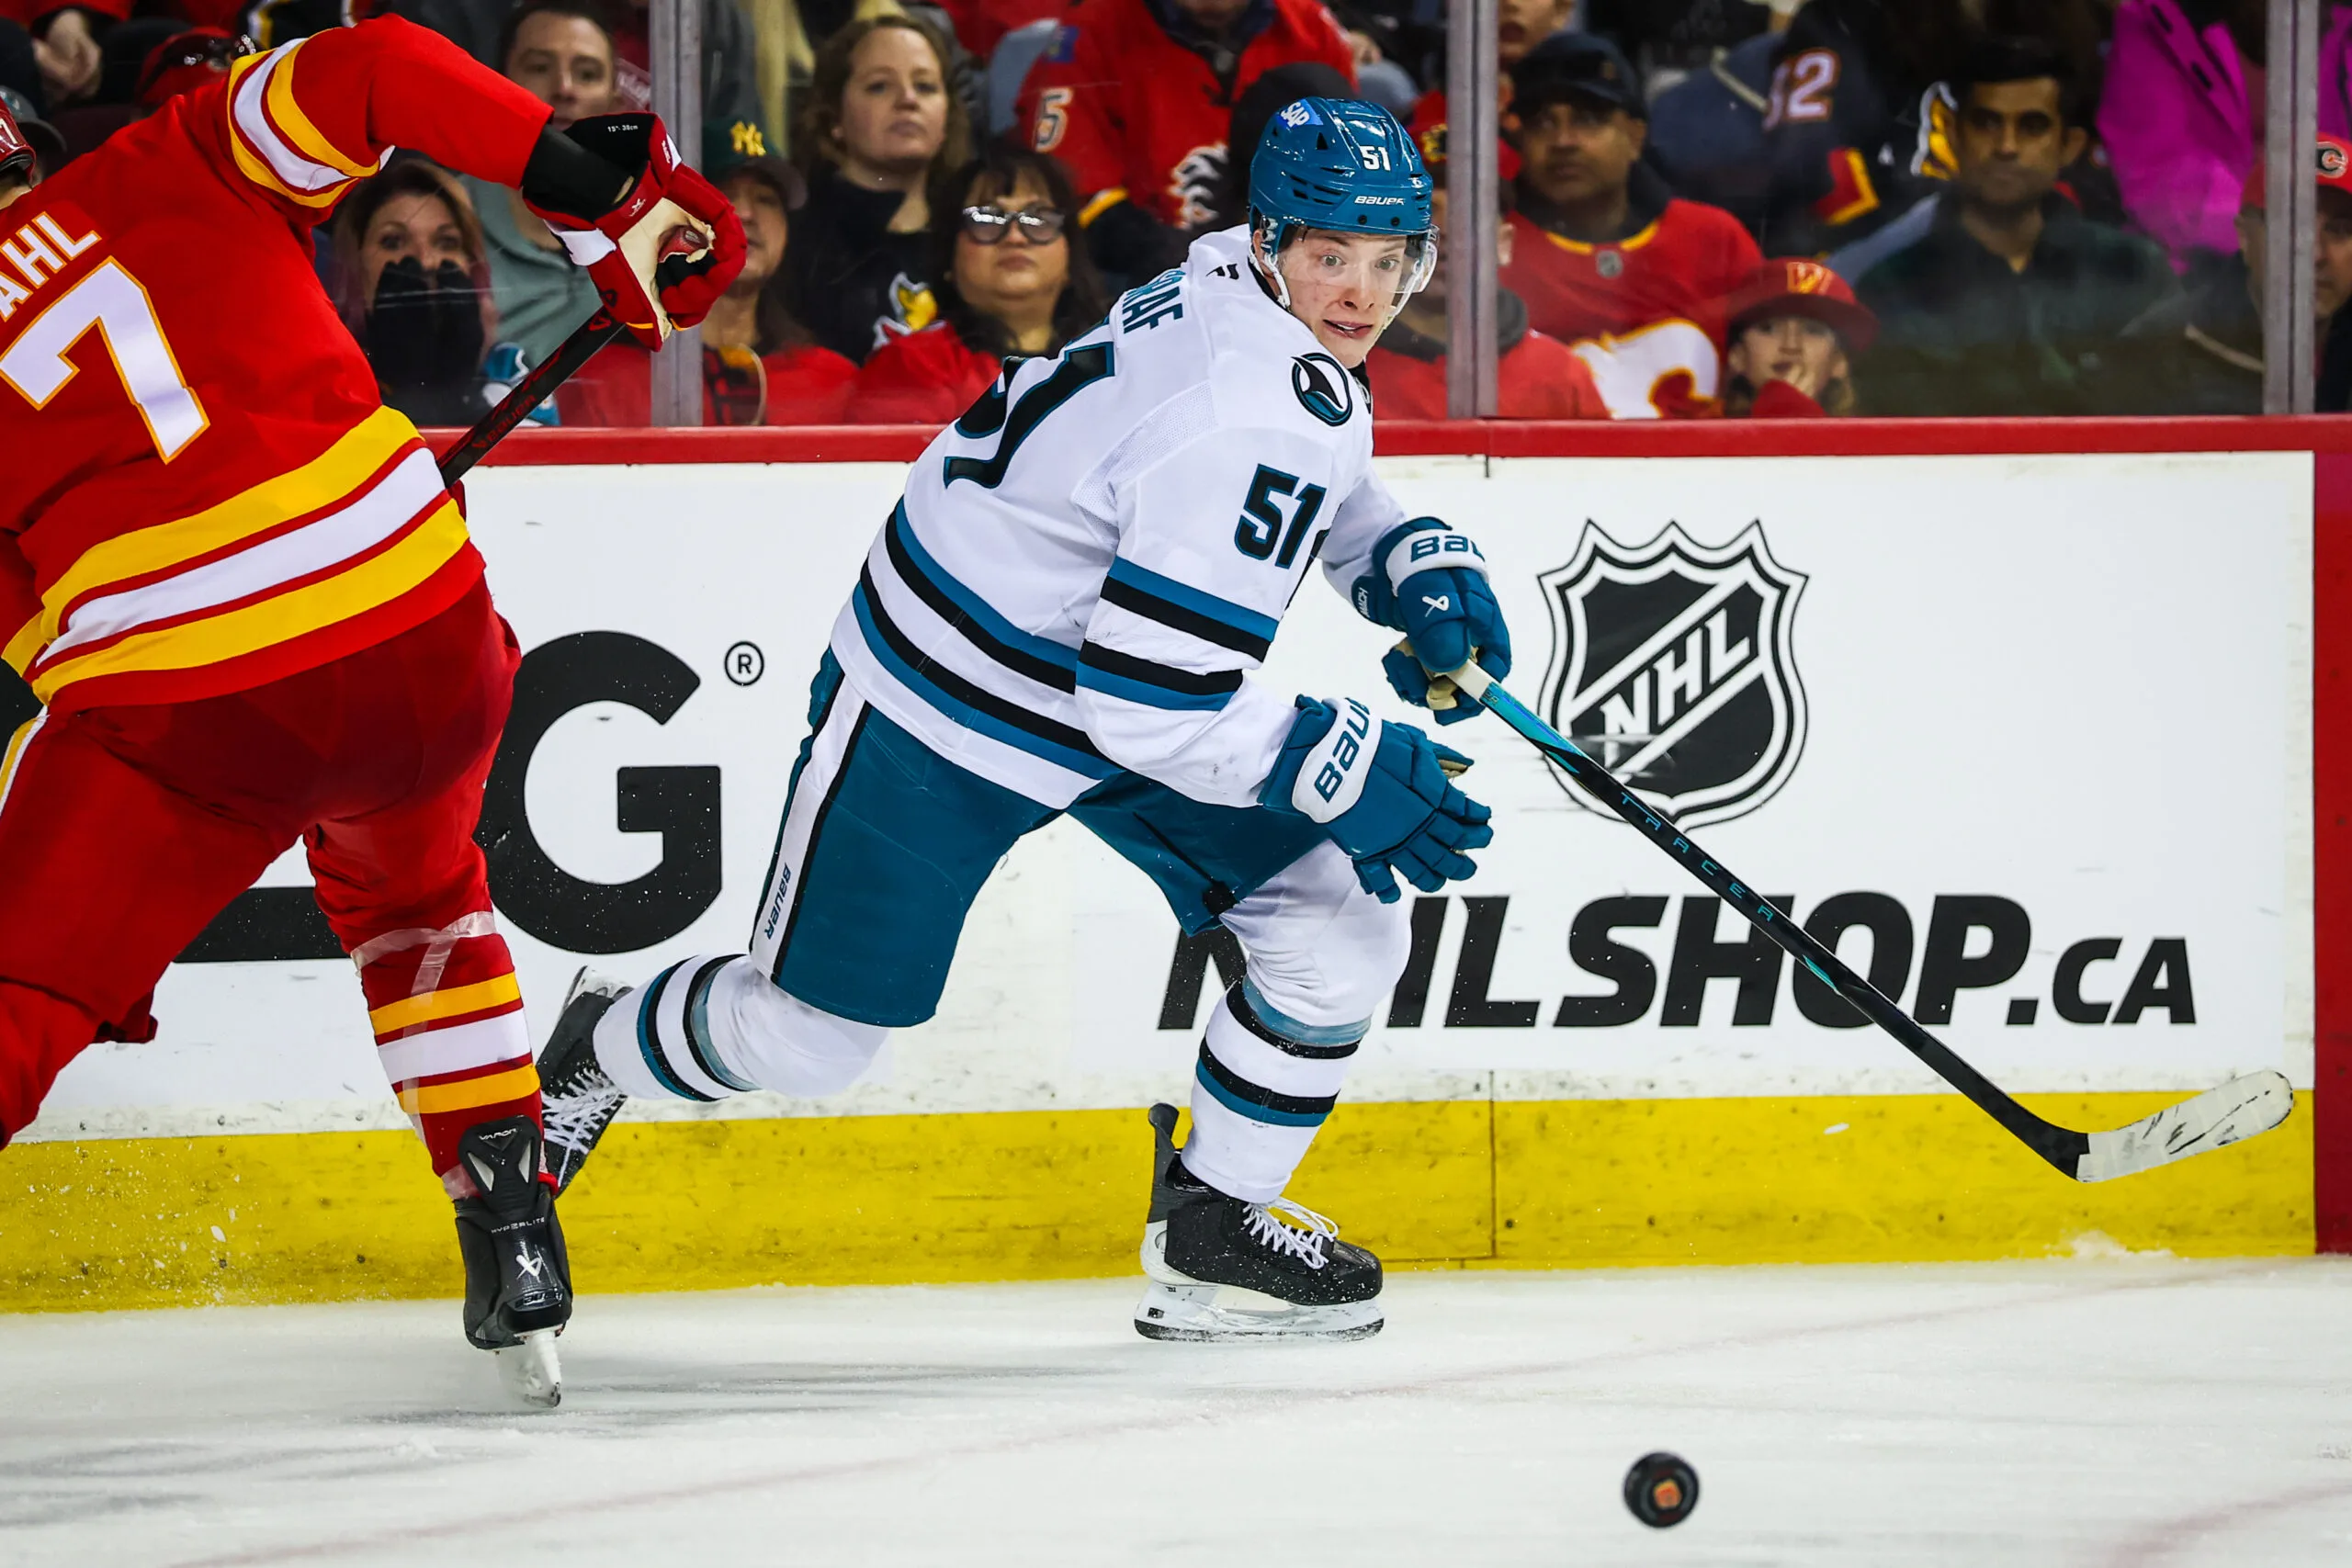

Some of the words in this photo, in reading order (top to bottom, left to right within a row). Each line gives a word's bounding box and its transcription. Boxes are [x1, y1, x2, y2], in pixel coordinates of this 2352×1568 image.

[1281, 101, 1310, 128] SAP
[1360, 146, 1391, 171] 51
[1354, 196, 1406, 206] BAUER
[1234, 463, 1327, 570] 51
[1600, 608, 1750, 768] NHL
[1621, 792, 1774, 922] TRACER
[764, 863, 791, 940] BAUER
